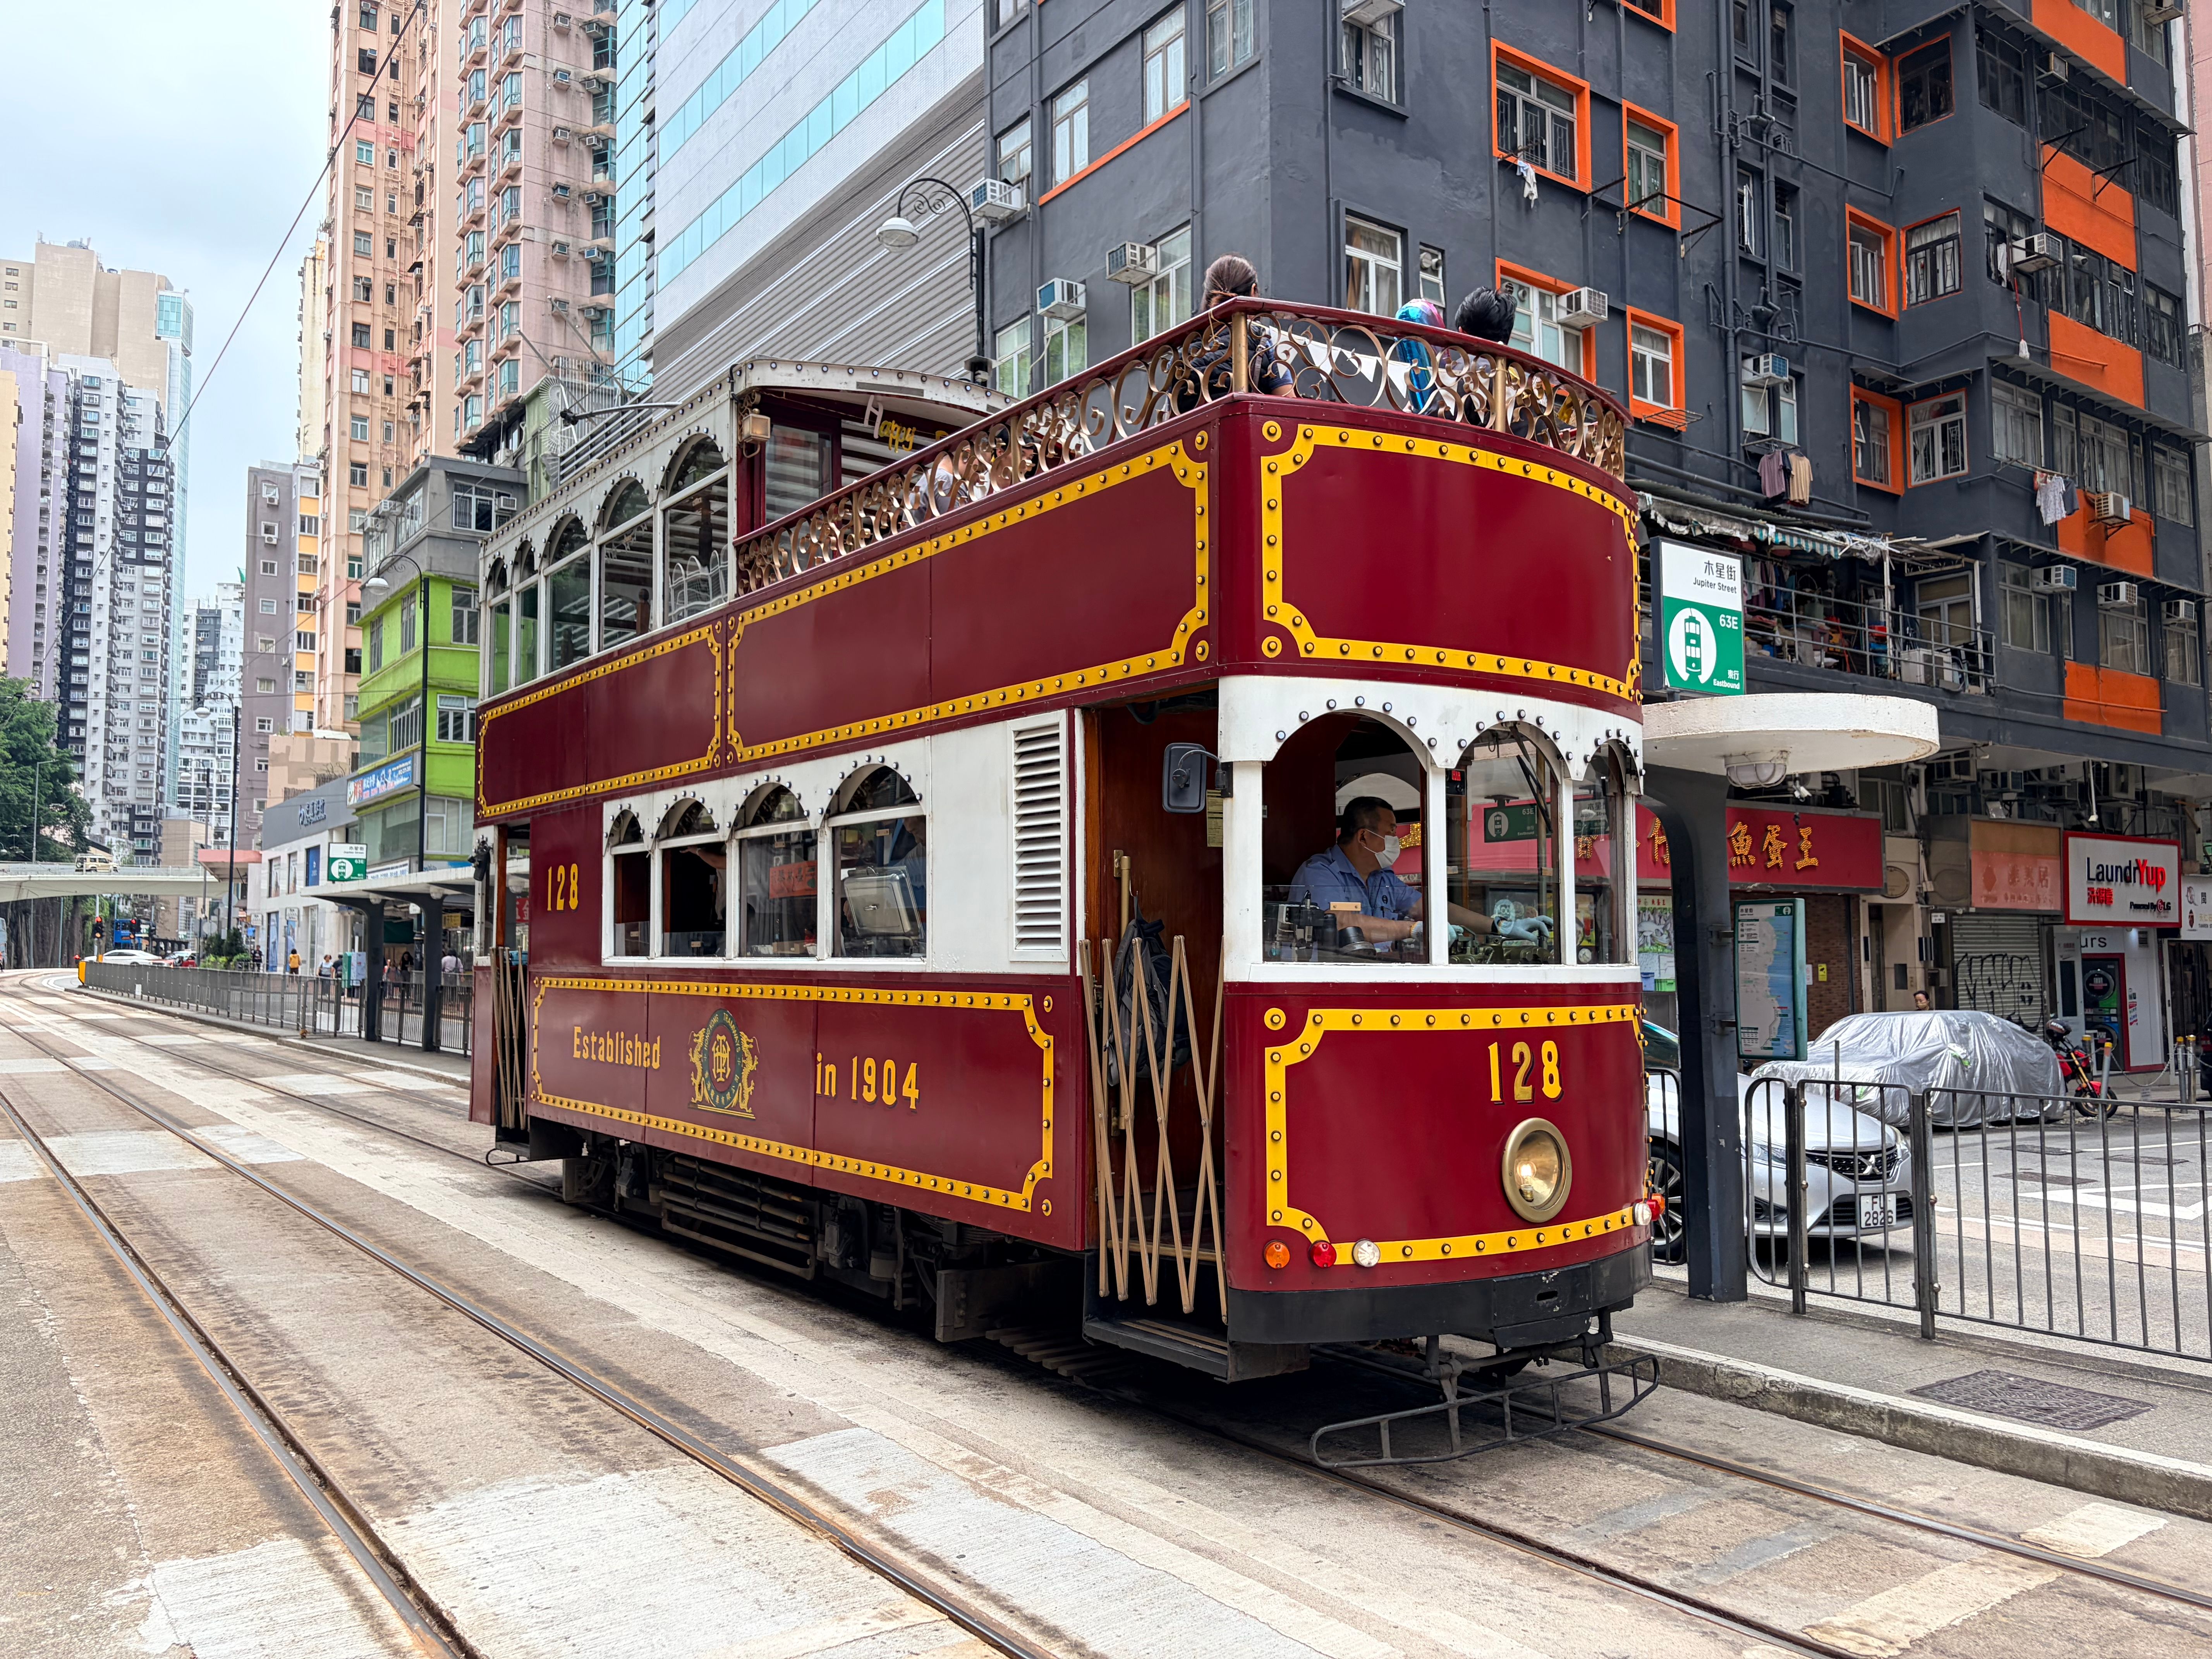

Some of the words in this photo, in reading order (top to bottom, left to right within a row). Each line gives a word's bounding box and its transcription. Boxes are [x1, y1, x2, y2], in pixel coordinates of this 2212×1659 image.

[864, 395, 917, 453] Happy
[1704, 560, 1736, 581] 木星街
[1693, 577, 1716, 590] Jupiter
[1718, 582, 1737, 594] Street
[1719, 614, 1738, 630] 63E
[1713, 678, 1740, 689] Eastbound
[1728, 669, 1739, 680] 東行
[1588, 802, 1605, 811] 木星
[1729, 821, 1819, 870] 魚蛋王
[2087, 857, 2166, 893] LaundrYup
[547, 863, 579, 911] 128
[2150, 903, 2157, 911] By
[709, 1014, 719, 1029] KONG
[723, 1012, 740, 1053] TRAMWAYS
[573, 1026, 661, 1070] Established
[816, 1052, 836, 1097] in
[851, 1055, 920, 1110] 1904
[1488, 1040, 1562, 1102] 128
[1865, 1210, 1893, 1226] 2826
